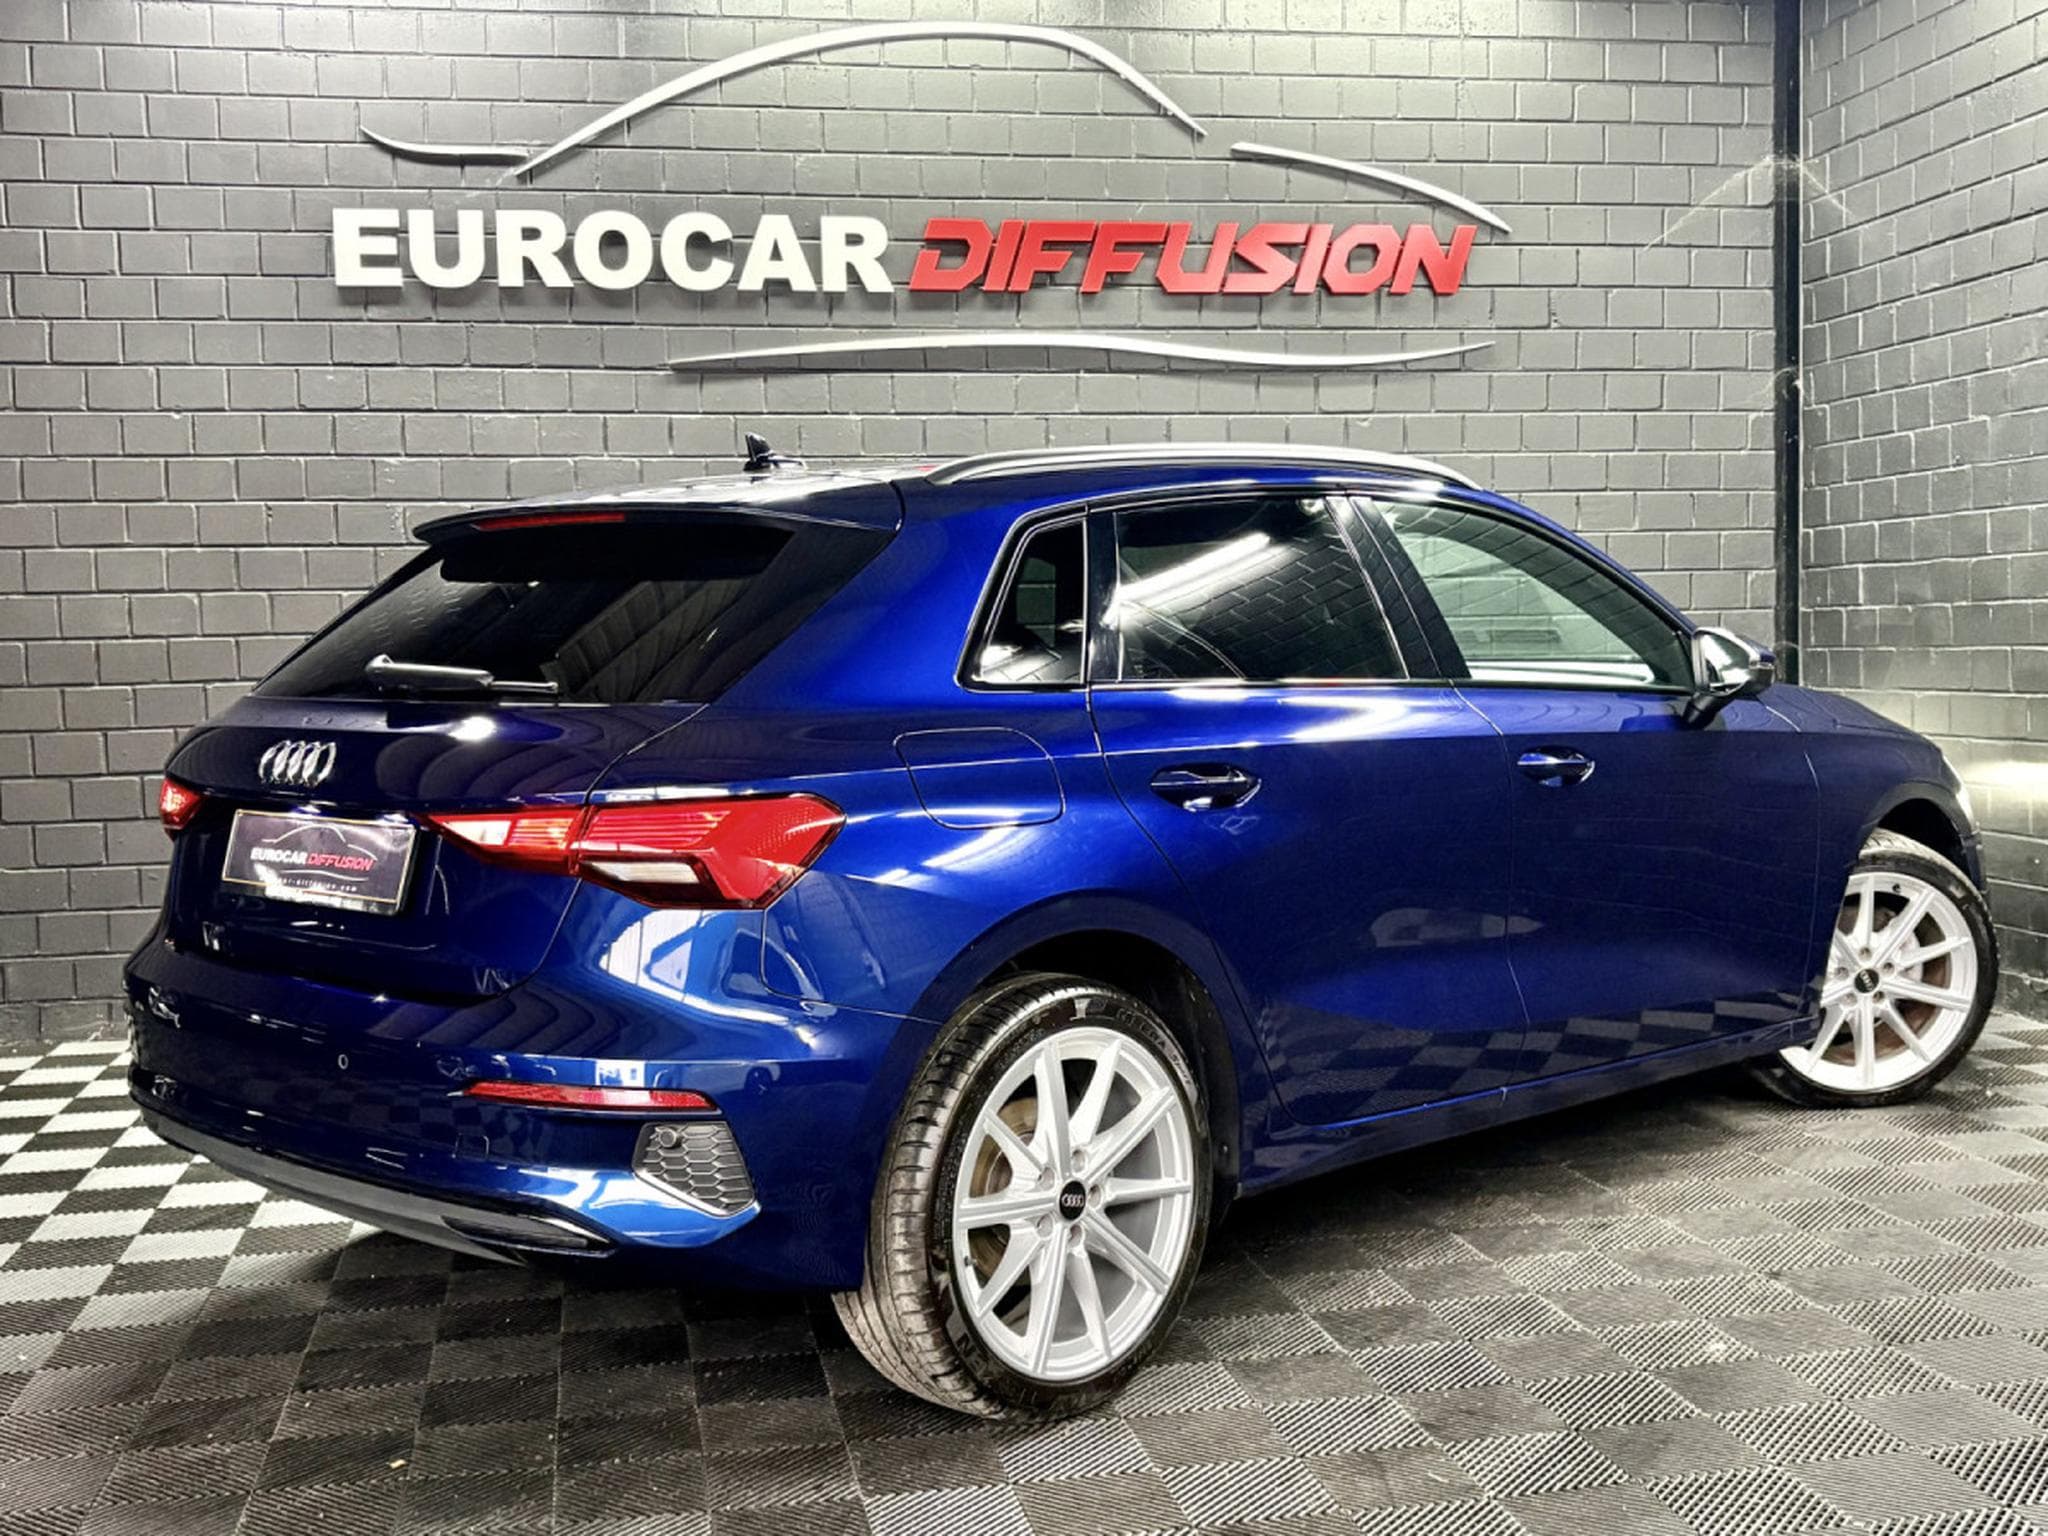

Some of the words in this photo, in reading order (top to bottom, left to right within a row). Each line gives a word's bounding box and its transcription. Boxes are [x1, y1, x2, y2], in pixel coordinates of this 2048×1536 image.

[331, 207, 894, 292] EUROCAR
[908, 217, 1478, 295] DIFFUSION
[250, 847, 308, 865] EUROCAR
[307, 852, 374, 871] DIFFUSION
